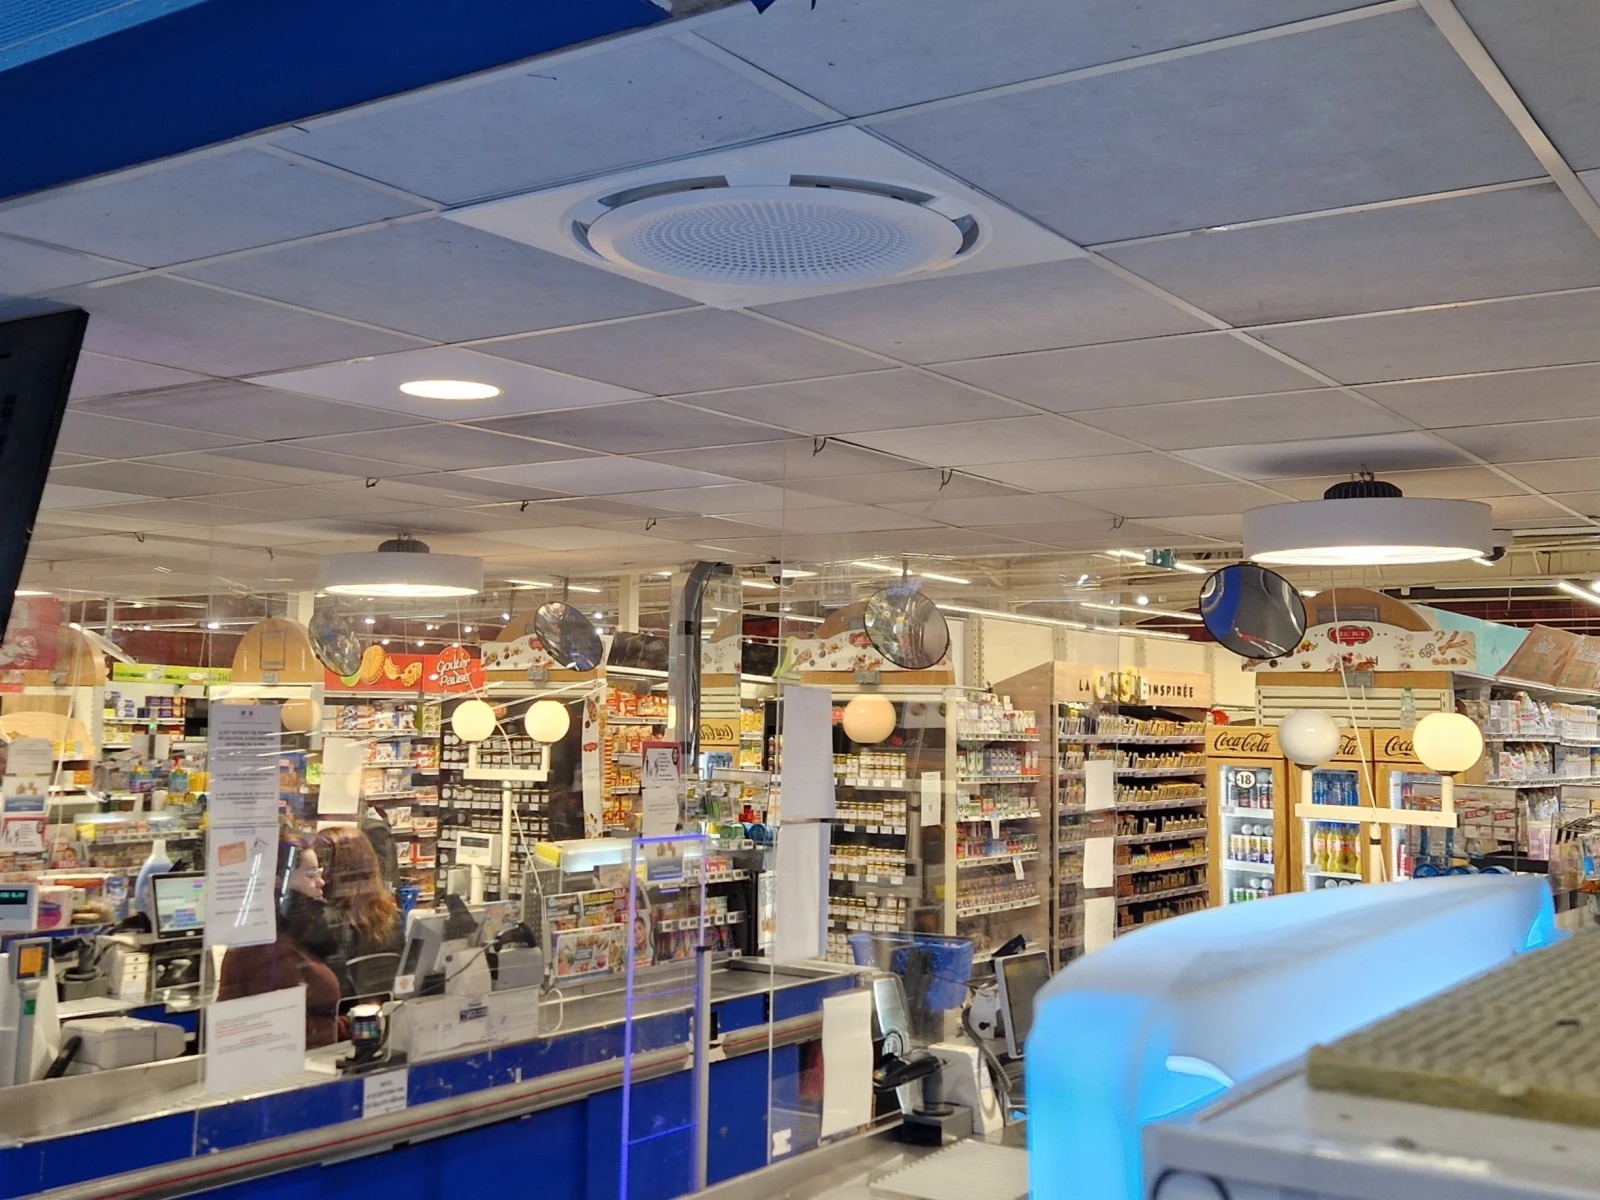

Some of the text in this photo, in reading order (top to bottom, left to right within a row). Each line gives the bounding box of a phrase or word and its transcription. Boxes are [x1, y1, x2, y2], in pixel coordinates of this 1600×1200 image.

[1078, 679, 1090, 691] LA
[1148, 684, 1194, 698] INSPIRÉE
[1214, 732, 1273, 752] Coca-Cola
